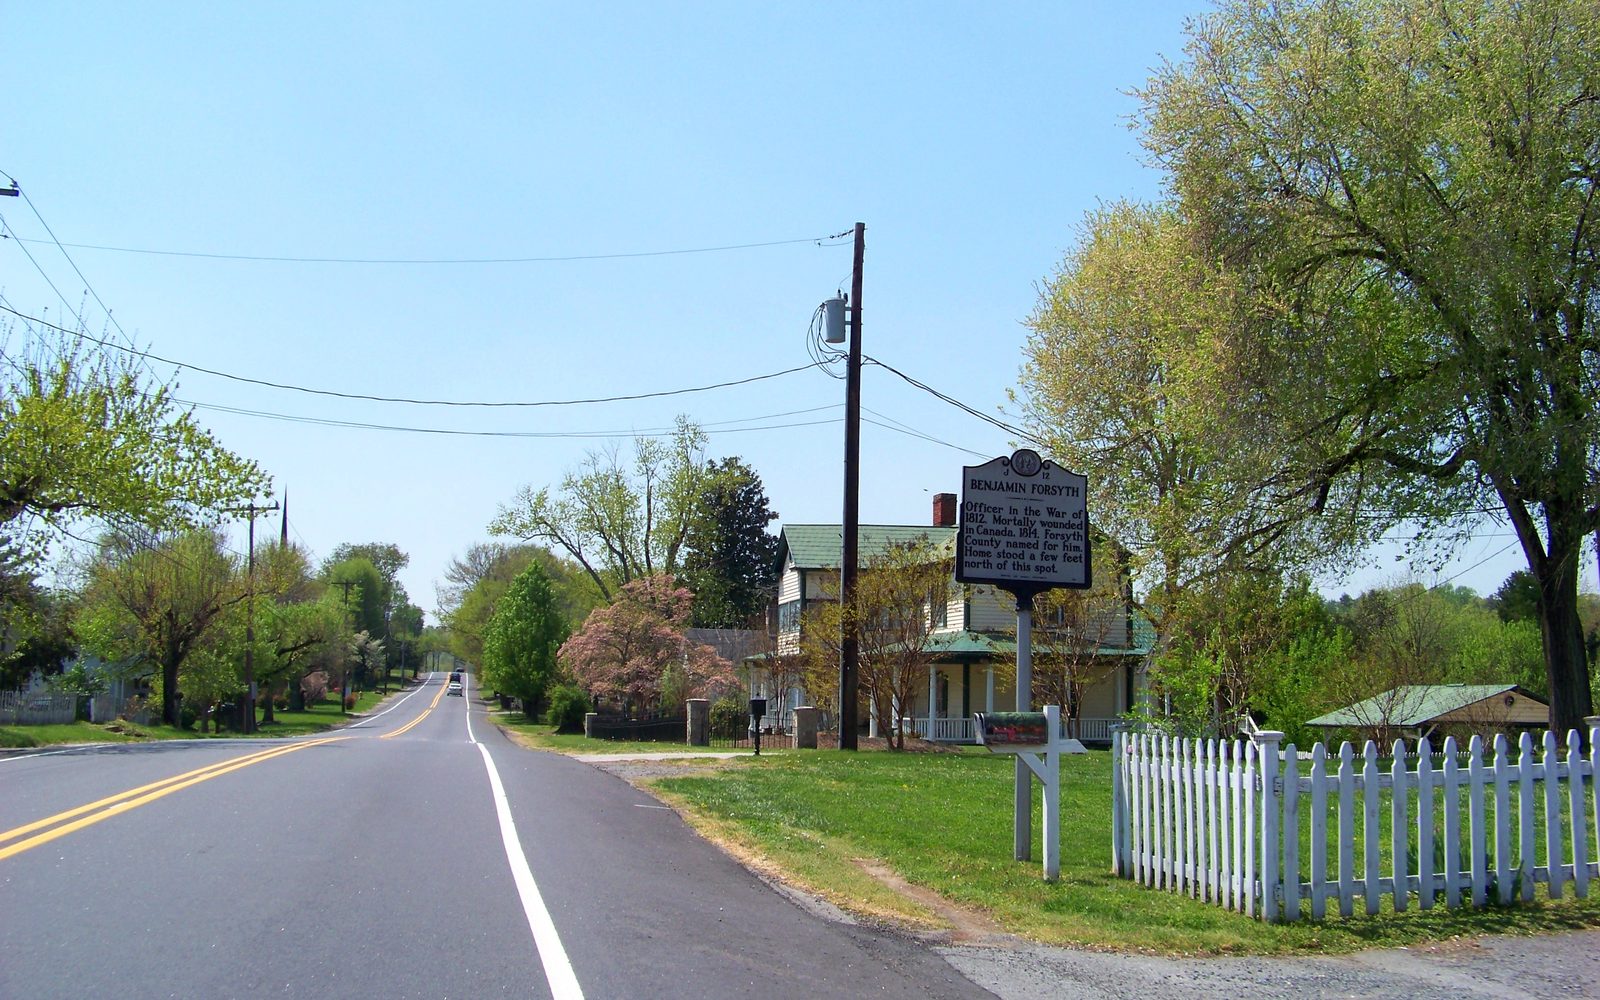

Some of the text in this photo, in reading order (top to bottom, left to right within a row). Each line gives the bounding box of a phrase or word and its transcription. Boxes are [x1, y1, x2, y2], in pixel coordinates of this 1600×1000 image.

[970, 479, 1080, 498] BENJAMIN FORSYTH
[965, 501, 1004, 514] Officer
[1024, 506, 1041, 517] the
[1046, 507, 1067, 519] War
[1072, 509, 1084, 520] of
[992, 514, 1036, 529] Mortally
[1040, 518, 1083, 530] wounded
[965, 525, 975, 535] in
[1019, 527, 1040, 540] 1814.
[1044, 529, 1083, 543] Forsyth
[965, 535, 1083, 553] County named for him.
[964, 546, 992, 558] Home
[996, 549, 1025, 560] stood
[1040, 551, 1058, 562] few
[1063, 552, 1083, 564] feet
[964, 559, 1058, 575] north of this spot.
